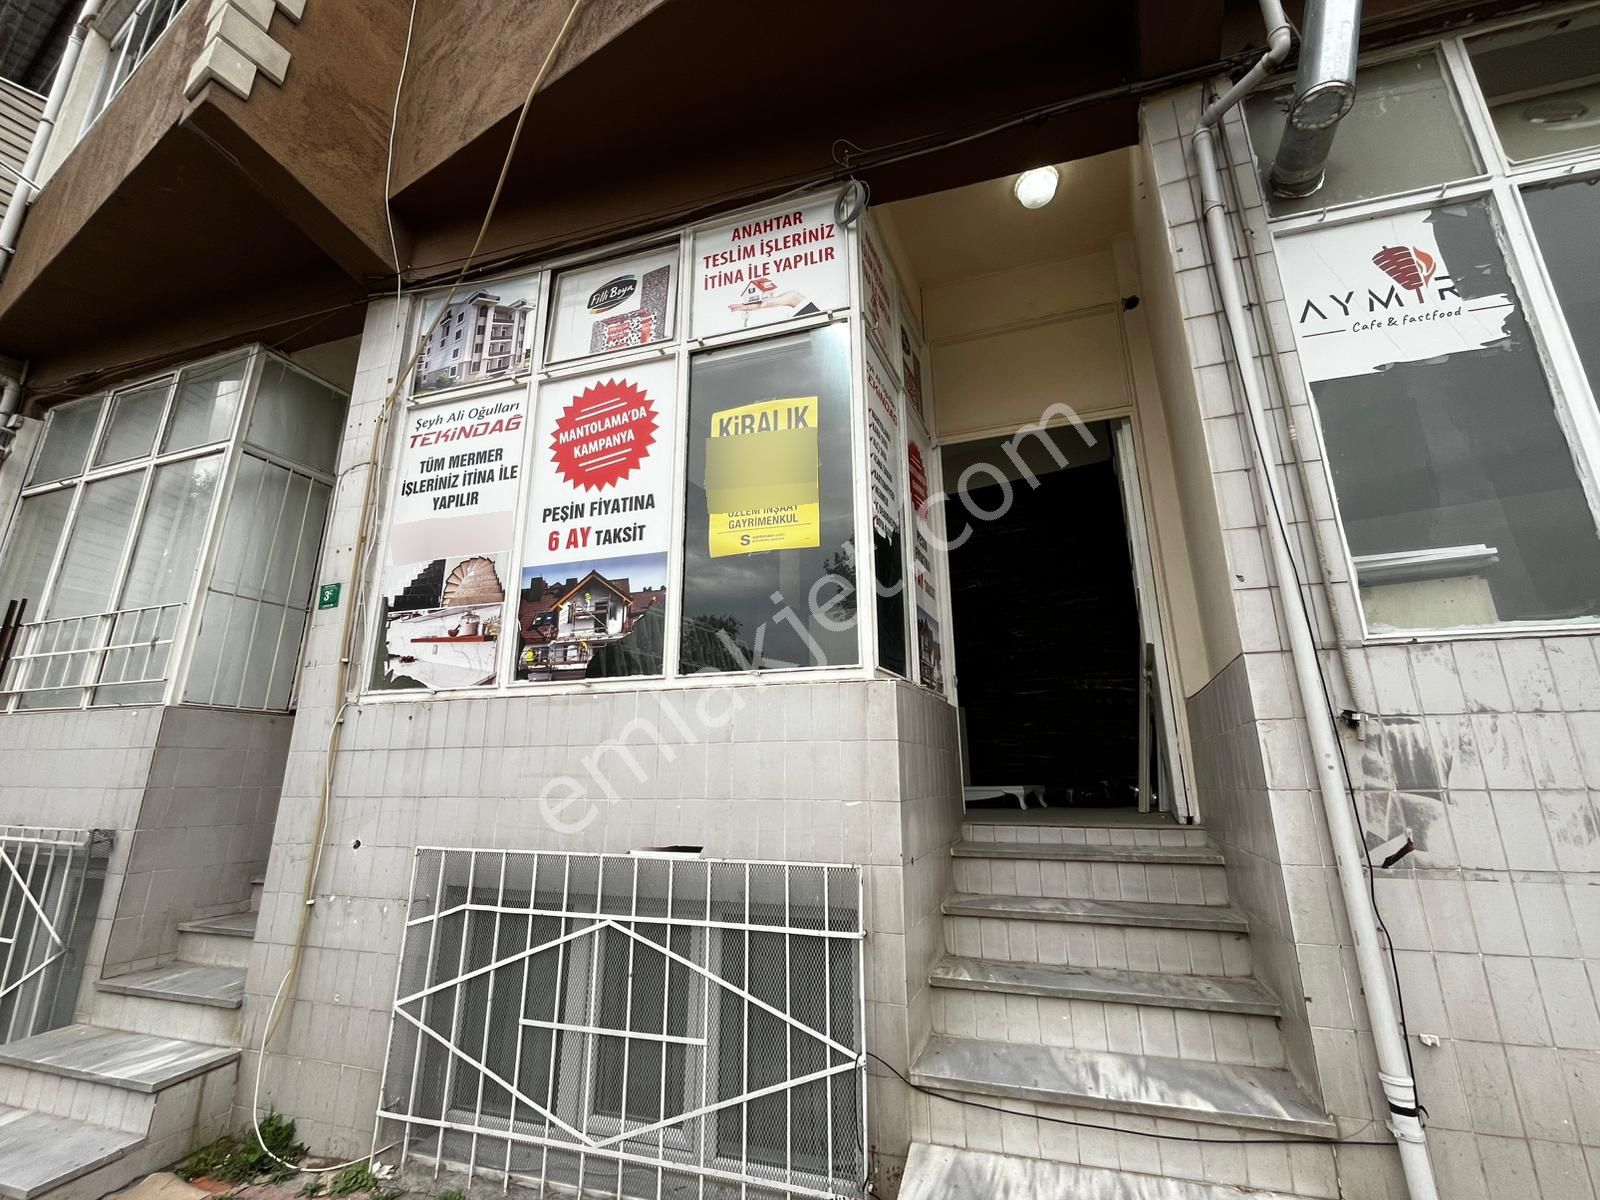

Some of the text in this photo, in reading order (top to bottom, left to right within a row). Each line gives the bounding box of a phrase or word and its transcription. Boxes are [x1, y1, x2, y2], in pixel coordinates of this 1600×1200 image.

[731, 211, 803, 242] ANAHTAR
[703, 223, 836, 269] TESLİM İŞLERİNİZ
[704, 246, 836, 291] İTİNA İLE YAPILIR
[591, 285, 635, 306] Filli Boya
[1352, 307, 1462, 333] Cafe & fastfood
[415, 402, 520, 432] Şeyh Ali Oğulları
[558, 405, 648, 446] MANTOLAMA'DA
[573, 428, 636, 459] KAMPANYA
[419, 448, 504, 474] TÜM MERMER
[401, 464, 519, 497] İŞLERİNİZ İTİNA İLE
[432, 491, 480, 511] YAPILIR
[542, 493, 656, 524] PEŞİN FİYATINA
[728, 513, 799, 530] GAYRİMENKUL
[548, 524, 647, 551] 6 AY TAKSİT
[740, 534, 751, 546] S
